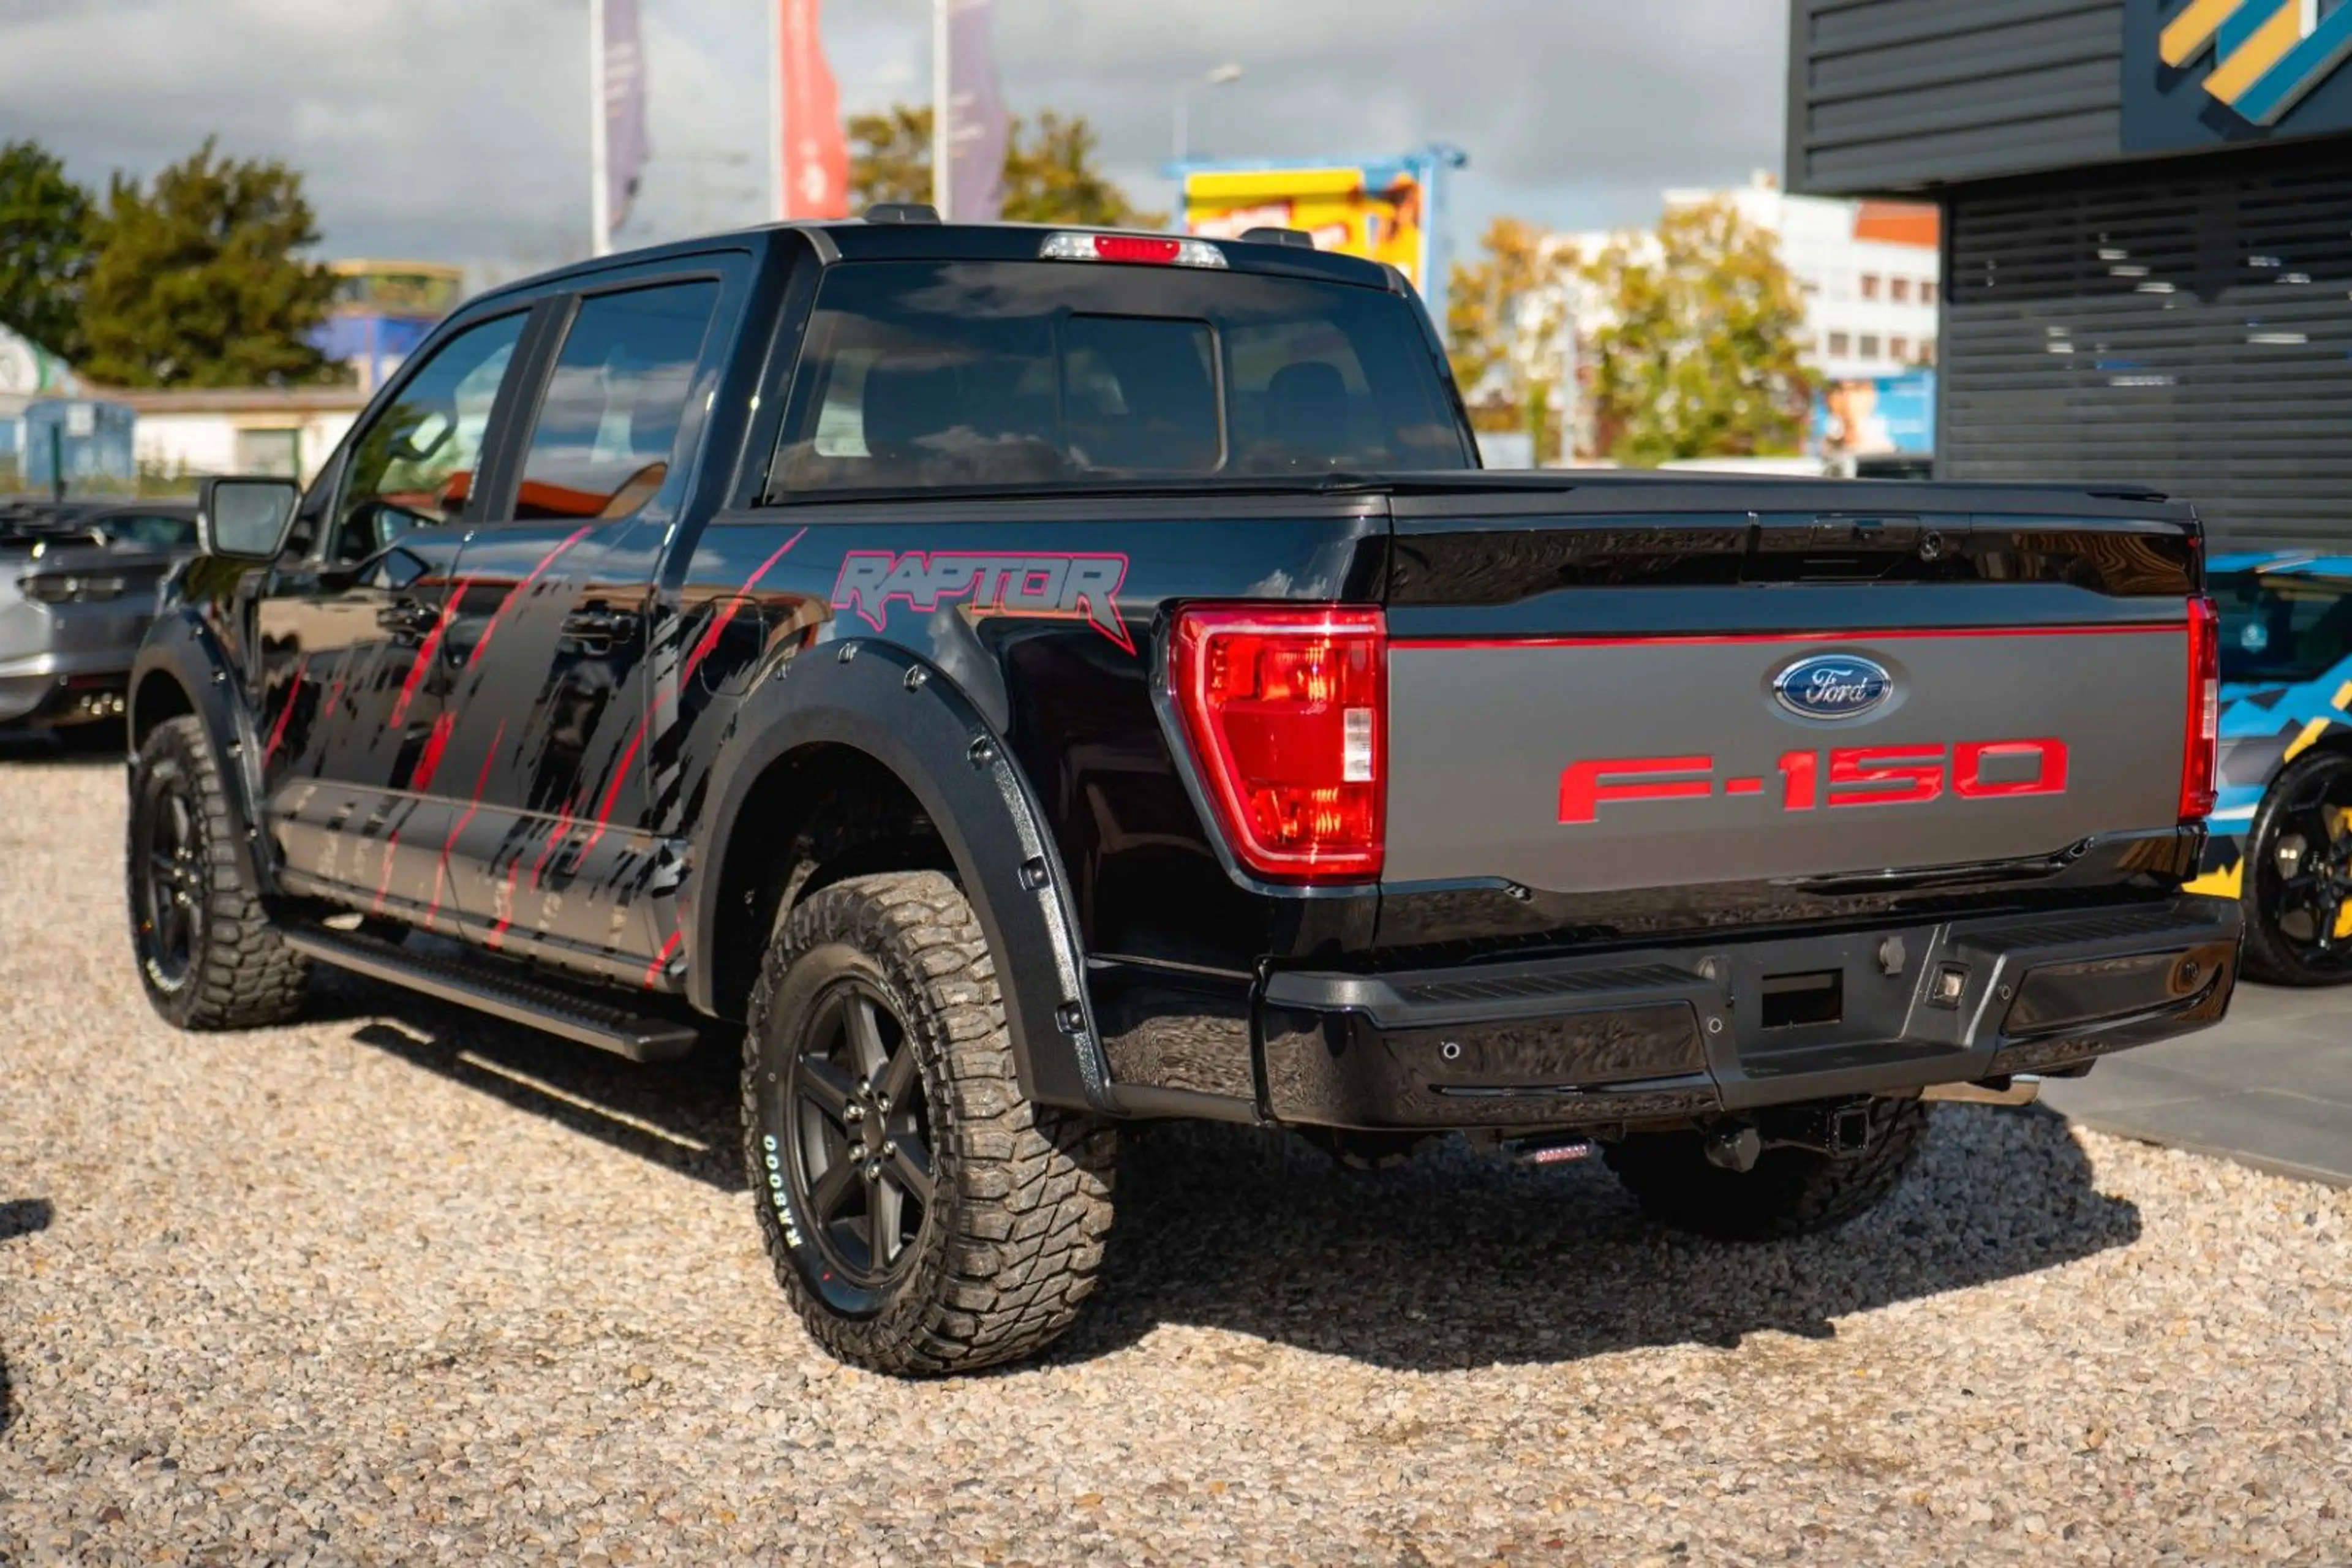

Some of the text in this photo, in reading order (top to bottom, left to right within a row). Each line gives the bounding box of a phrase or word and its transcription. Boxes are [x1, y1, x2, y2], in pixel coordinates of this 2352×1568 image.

[831, 550, 1137, 655] RAPTOR
[1806, 668, 1867, 704] Ford
[1558, 737, 2068, 824] F-150
[763, 1134, 803, 1248] RA8000
